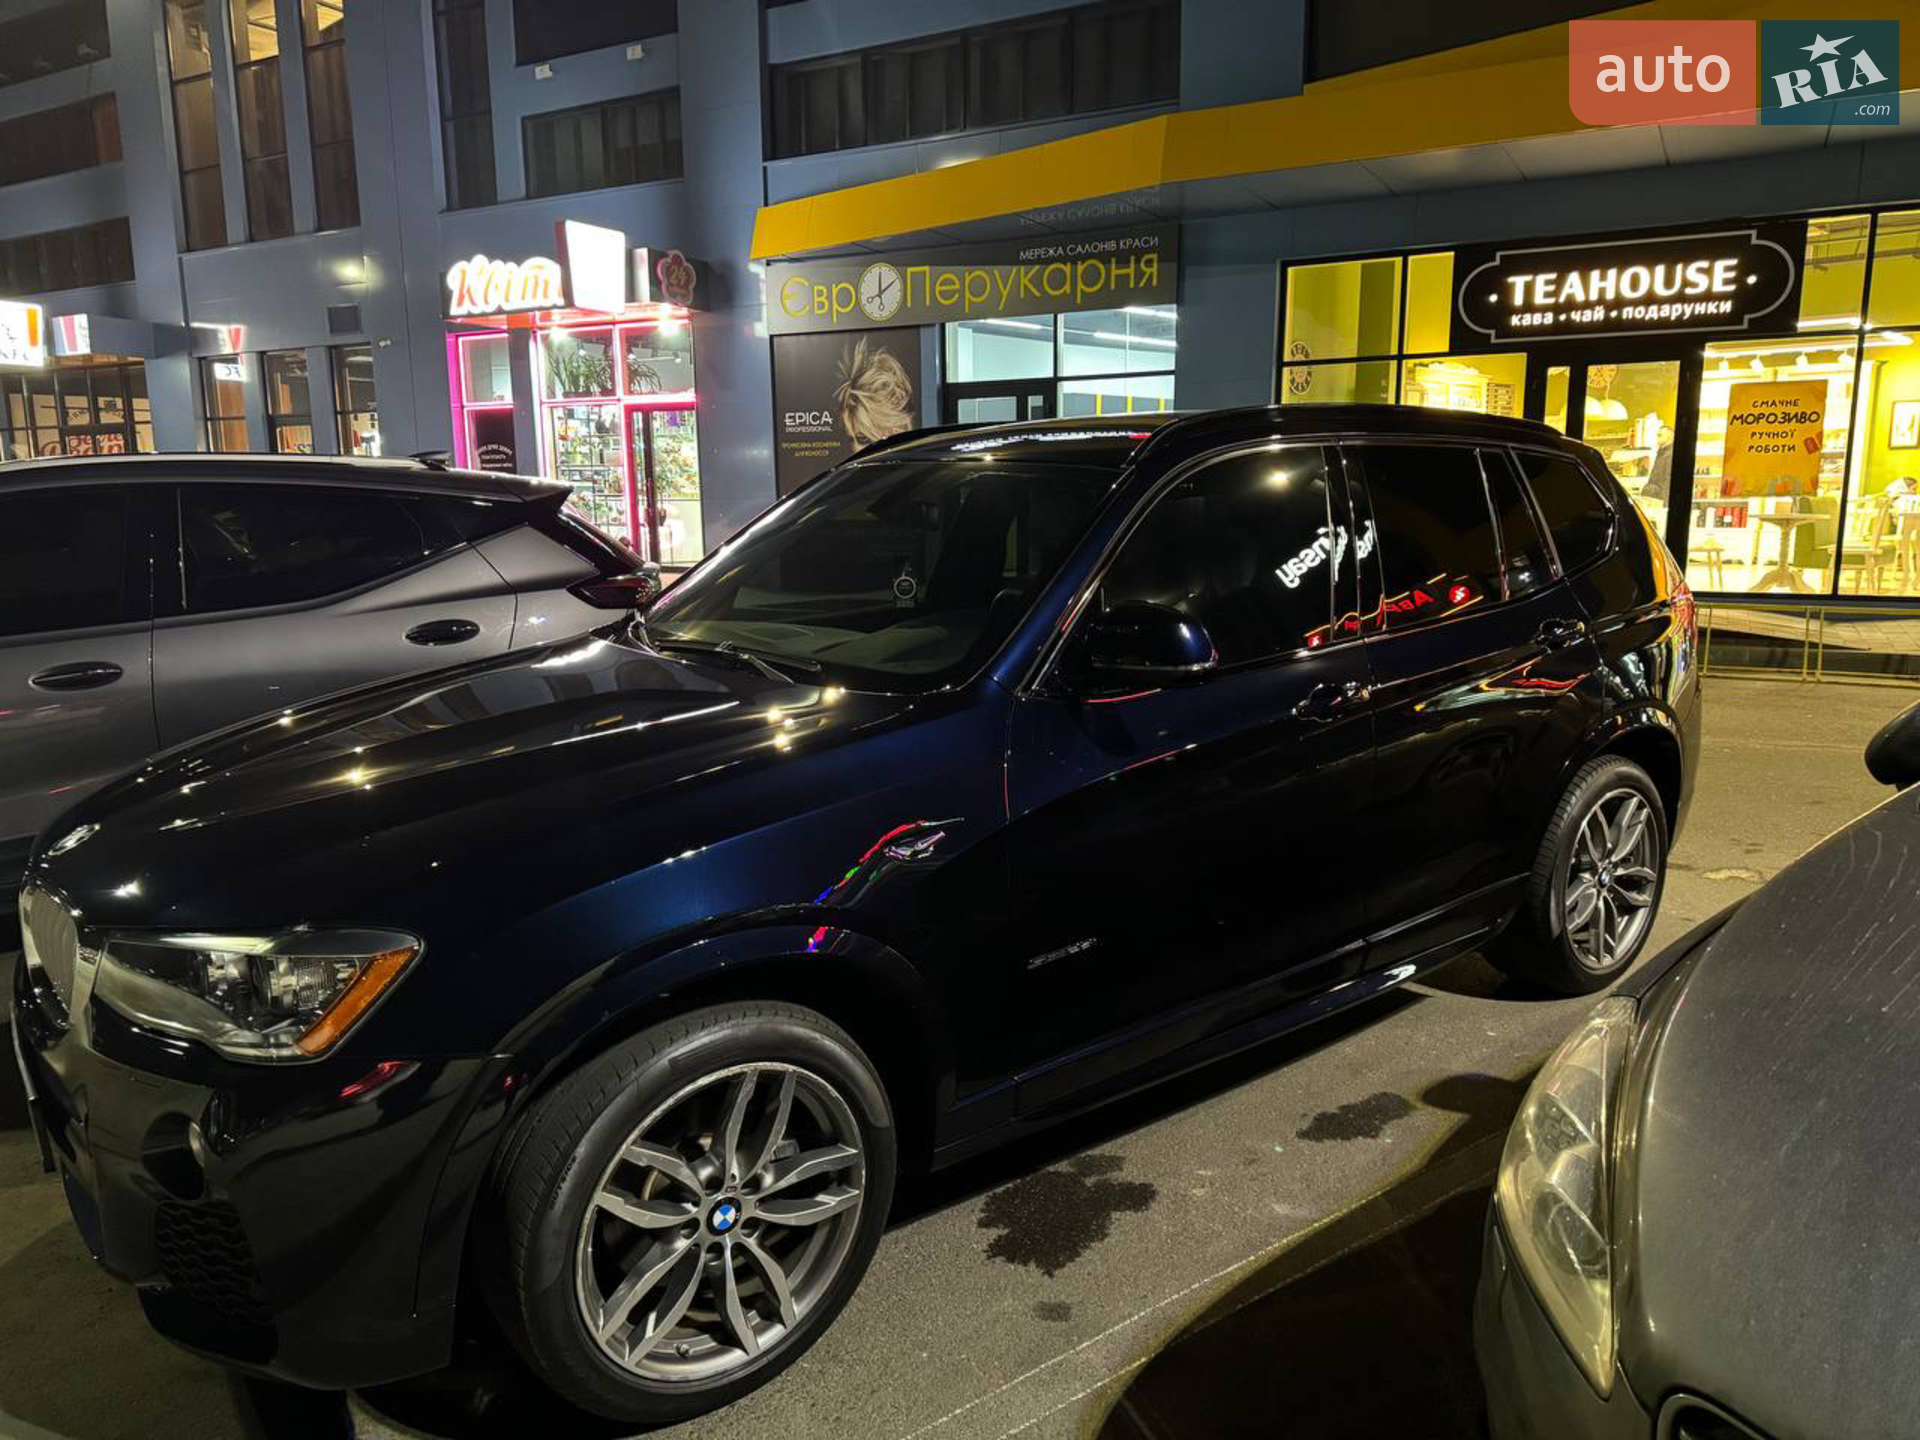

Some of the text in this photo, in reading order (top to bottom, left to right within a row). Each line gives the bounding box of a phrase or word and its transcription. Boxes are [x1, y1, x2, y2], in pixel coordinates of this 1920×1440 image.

[1020, 236, 1159, 260] МЕРЕЖА САЛОНІВ КРАСИ
[1506, 258, 1738, 307] TEAHOUSE
[1511, 300, 1732, 326] кава чай подарунки
[1752, 399, 1800, 408] СМАЧНЕ
[784, 411, 833, 425] EPICA
[1730, 411, 1820, 425] МОРОЗИВО
[1750, 429, 1797, 439] РУЧНОЇ
[1747, 444, 1796, 453] РОБОТИ
